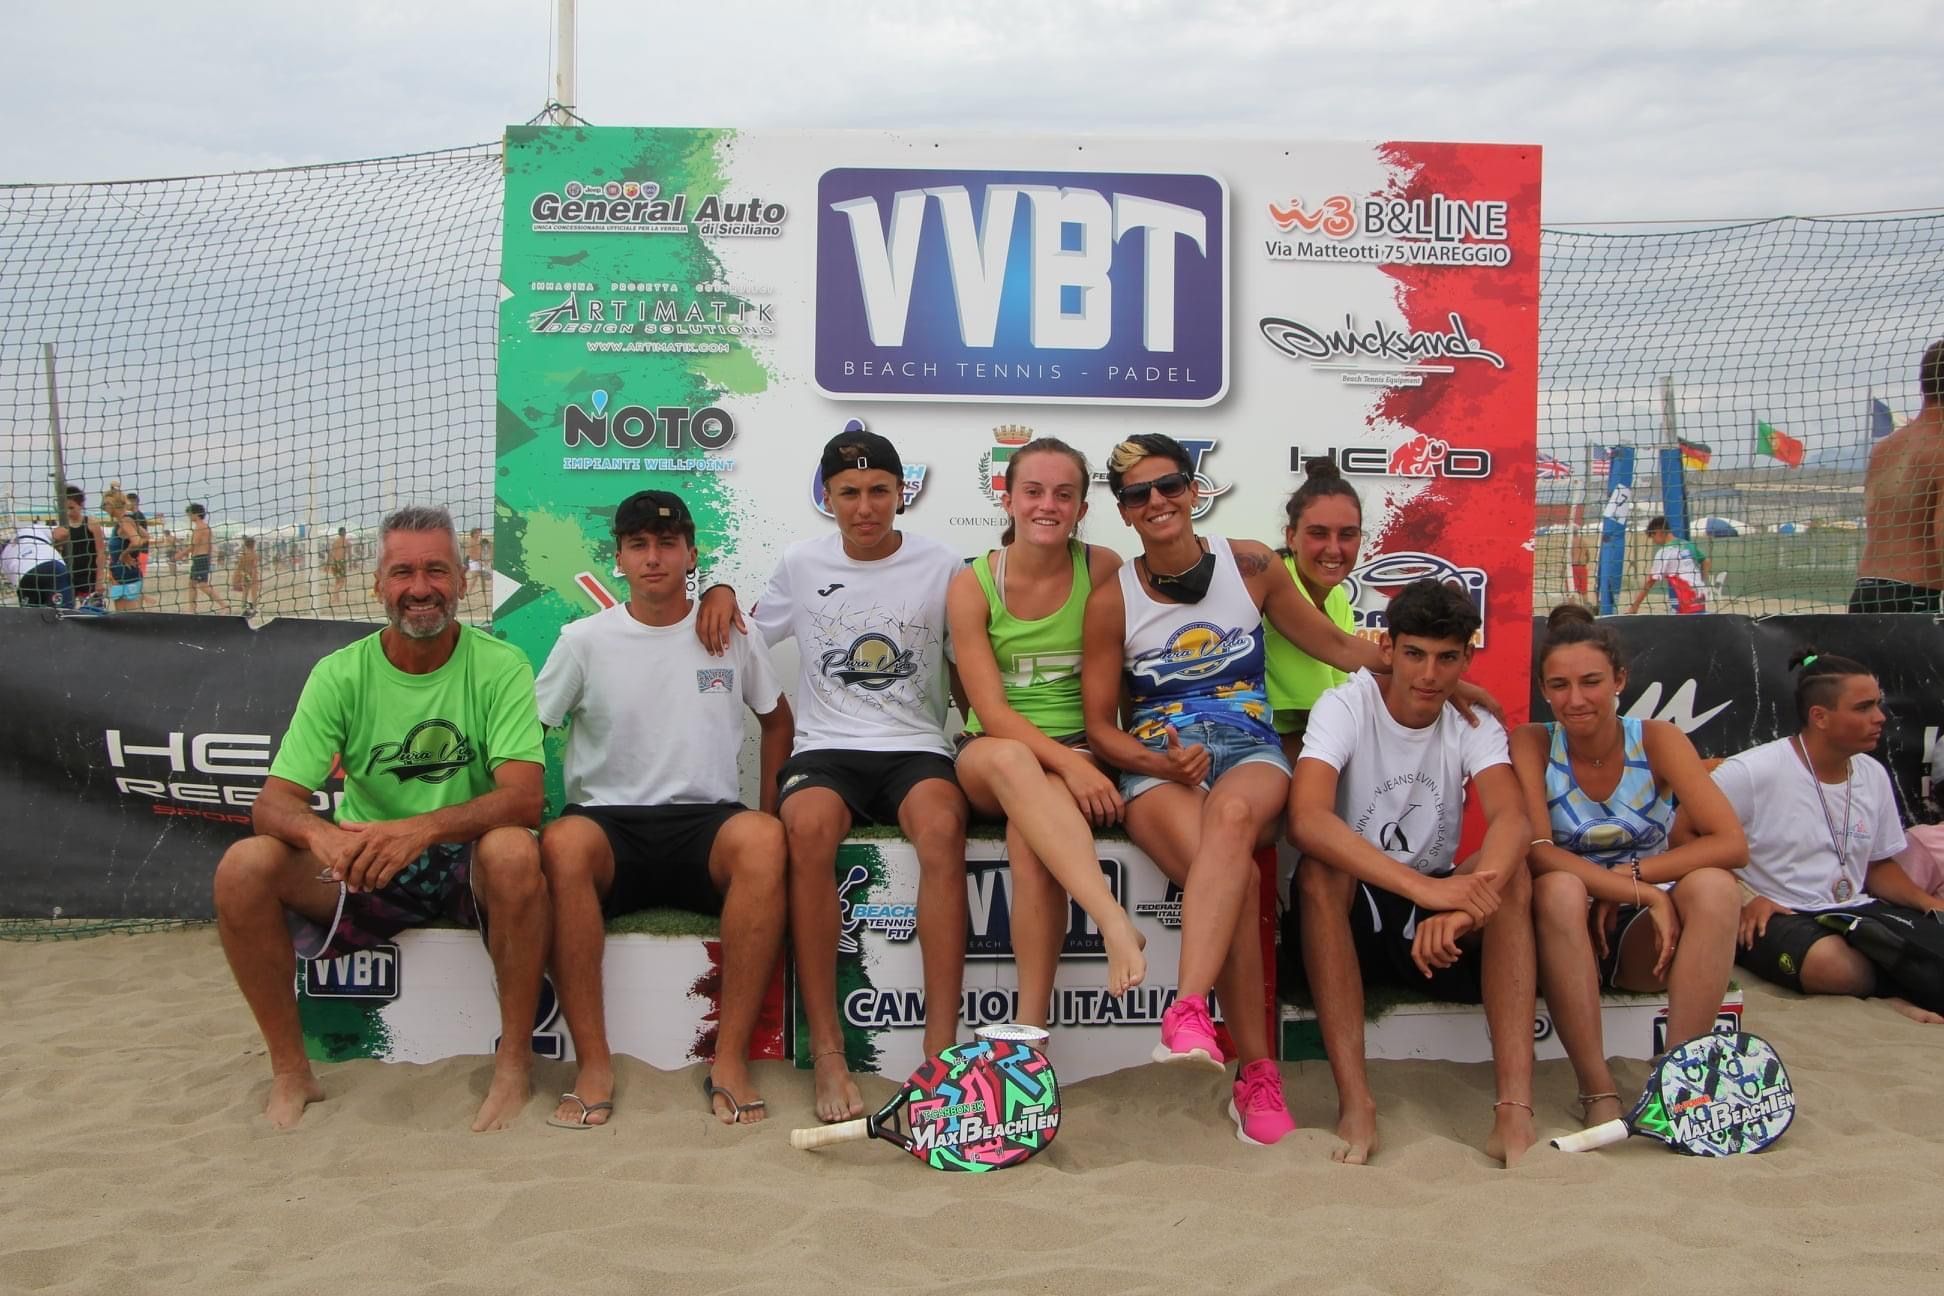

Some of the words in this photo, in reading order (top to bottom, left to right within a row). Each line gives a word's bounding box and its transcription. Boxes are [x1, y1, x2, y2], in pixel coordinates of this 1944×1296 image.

[532, 193, 685, 222] General
[694, 196, 786, 223] Auto
[701, 223, 714, 234] di
[718, 223, 780, 235] Siciliano
[1265, 241, 1292, 257] Via
[1297, 242, 1379, 259] Matteotti
[1384, 244, 1405, 260] 75
[1409, 245, 1508, 263] VIAREGGIO
[830, 184, 1206, 352] VVBT
[611, 283, 678, 292] PROGETTA
[532, 292, 774, 333] ARTIMATIK
[545, 323, 633, 333] DESIGN
[645, 324, 774, 335] SOLUTIONS
[1259, 313, 1503, 366] Quicksand
[587, 341, 730, 353] WWW.ARTIMATIK.COM
[844, 361, 937, 376] BEACH
[957, 363, 1061, 379] TENNIS
[1108, 366, 1196, 382] PADEL
[1364, 375, 1384, 383] Tennis
[1386, 376, 1421, 385] Equipment
[564, 404, 734, 449] NOTO
[563, 458, 641, 470] IMPIANTI
[645, 458, 736, 471] WELLPOINT
[949, 517, 997, 526] COMUNE
[821, 649, 871, 677] Pura
[105, 729, 271, 776] HE
[365, 741, 432, 776] Pura
[1383, 773, 1414, 793] JEANS
[1416, 771, 1437, 792] LVIN
[152, 804, 251, 825] SPOR
[853, 906, 917, 918] BEACH
[1136, 903, 1182, 911] FEDERAZI
[868, 919, 916, 928] TENNIS
[888, 929, 911, 938] FIT
[969, 940, 1001, 949] EACH
[1070, 940, 1102, 948] PADE
[314, 950, 393, 986] VVBT
[848, 991, 1051, 1023] CAMIO
[1063, 989, 1180, 1020] ITALI
[970, 1100, 985, 1113] 3K
